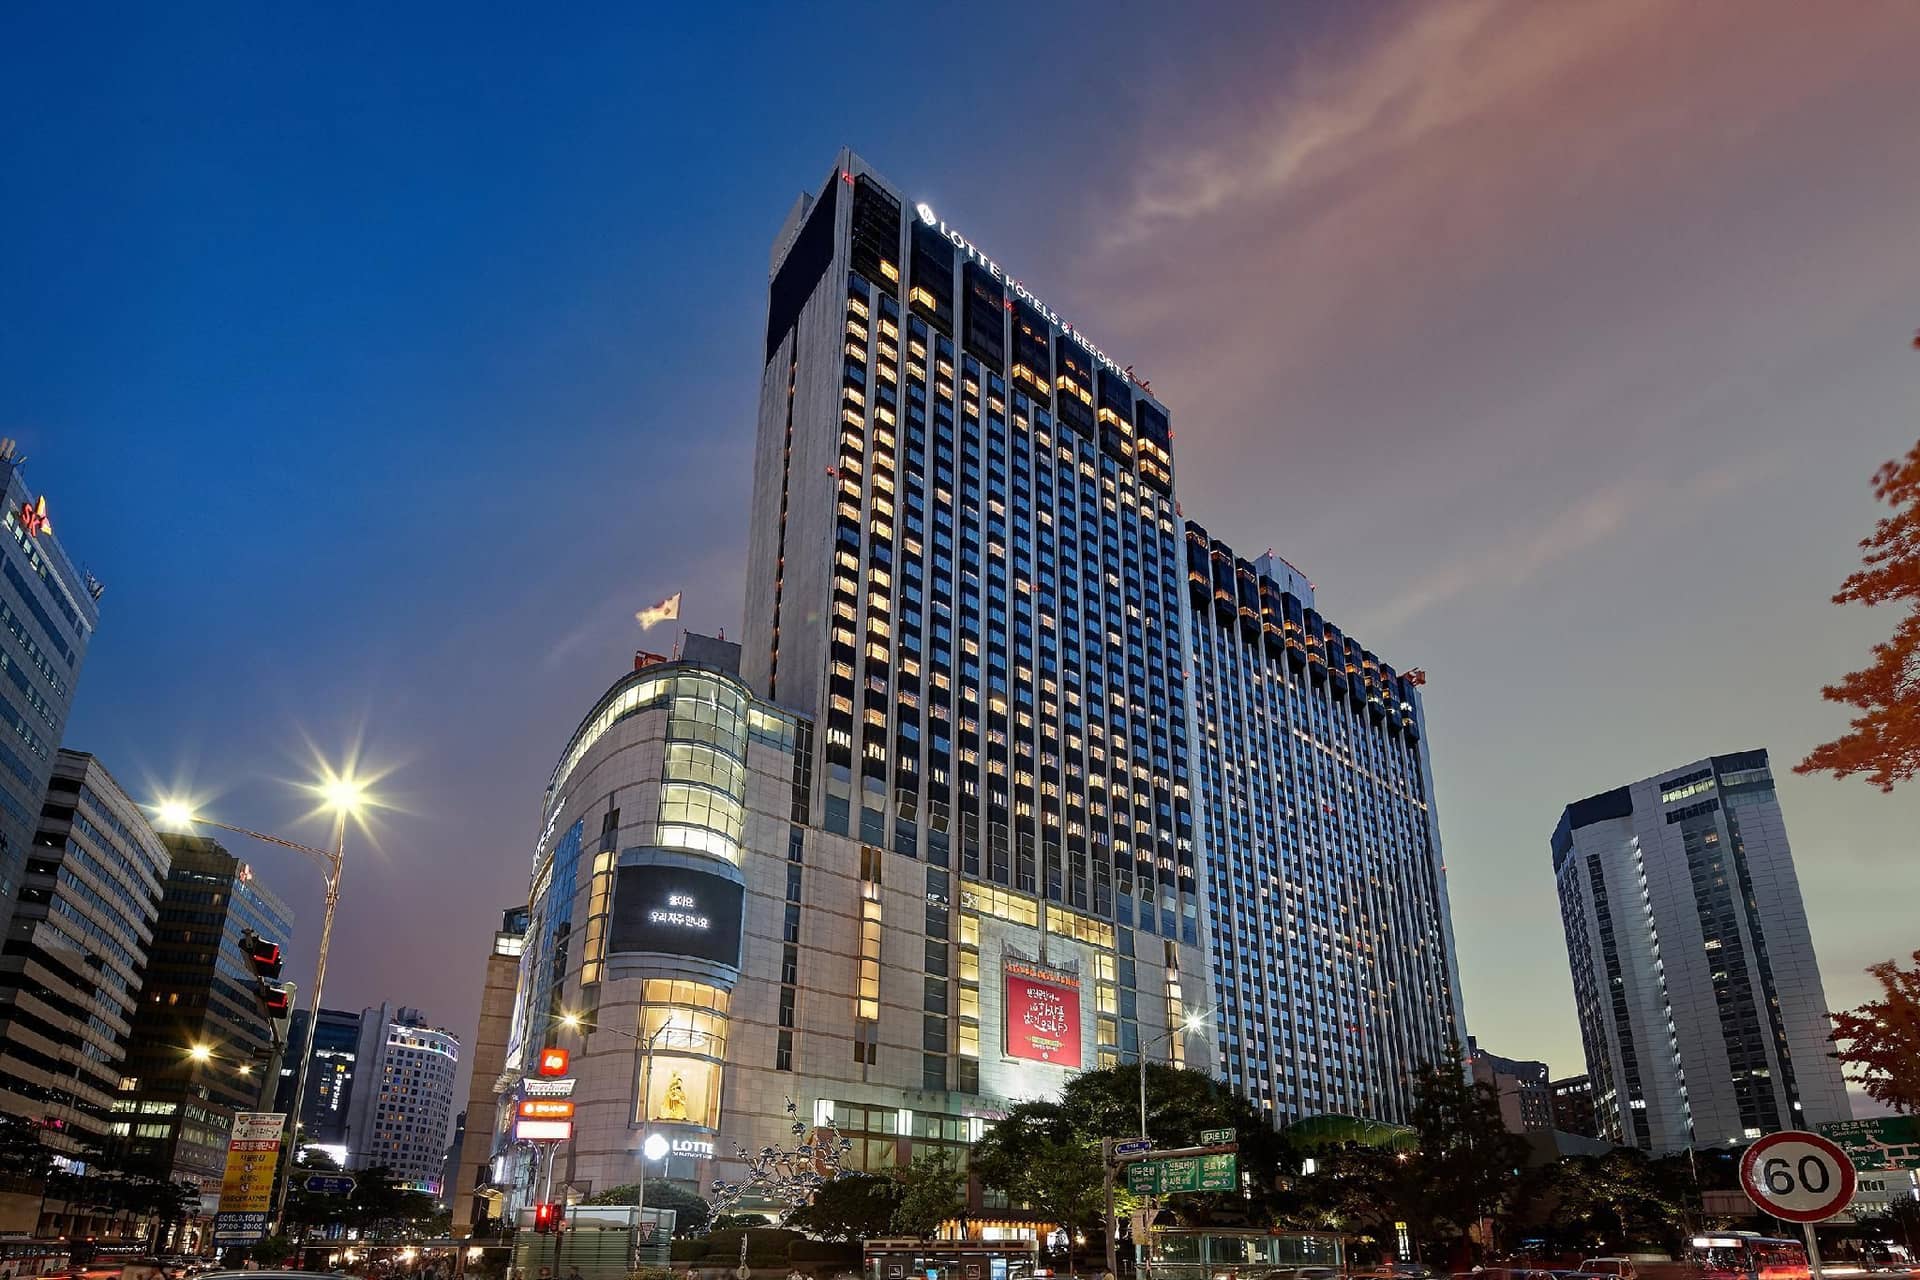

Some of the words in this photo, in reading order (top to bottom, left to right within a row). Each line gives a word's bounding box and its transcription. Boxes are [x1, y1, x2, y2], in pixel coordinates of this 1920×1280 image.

[941, 221, 1001, 279] LOTTE
[1006, 275, 1058, 325] HOTELS
[1061, 322, 1070, 334] &
[1073, 329, 1129, 383] RESORTS
[22, 503, 40, 537] SK
[673, 1139, 714, 1154] LOTTE
[1763, 1155, 1830, 1195] 60
